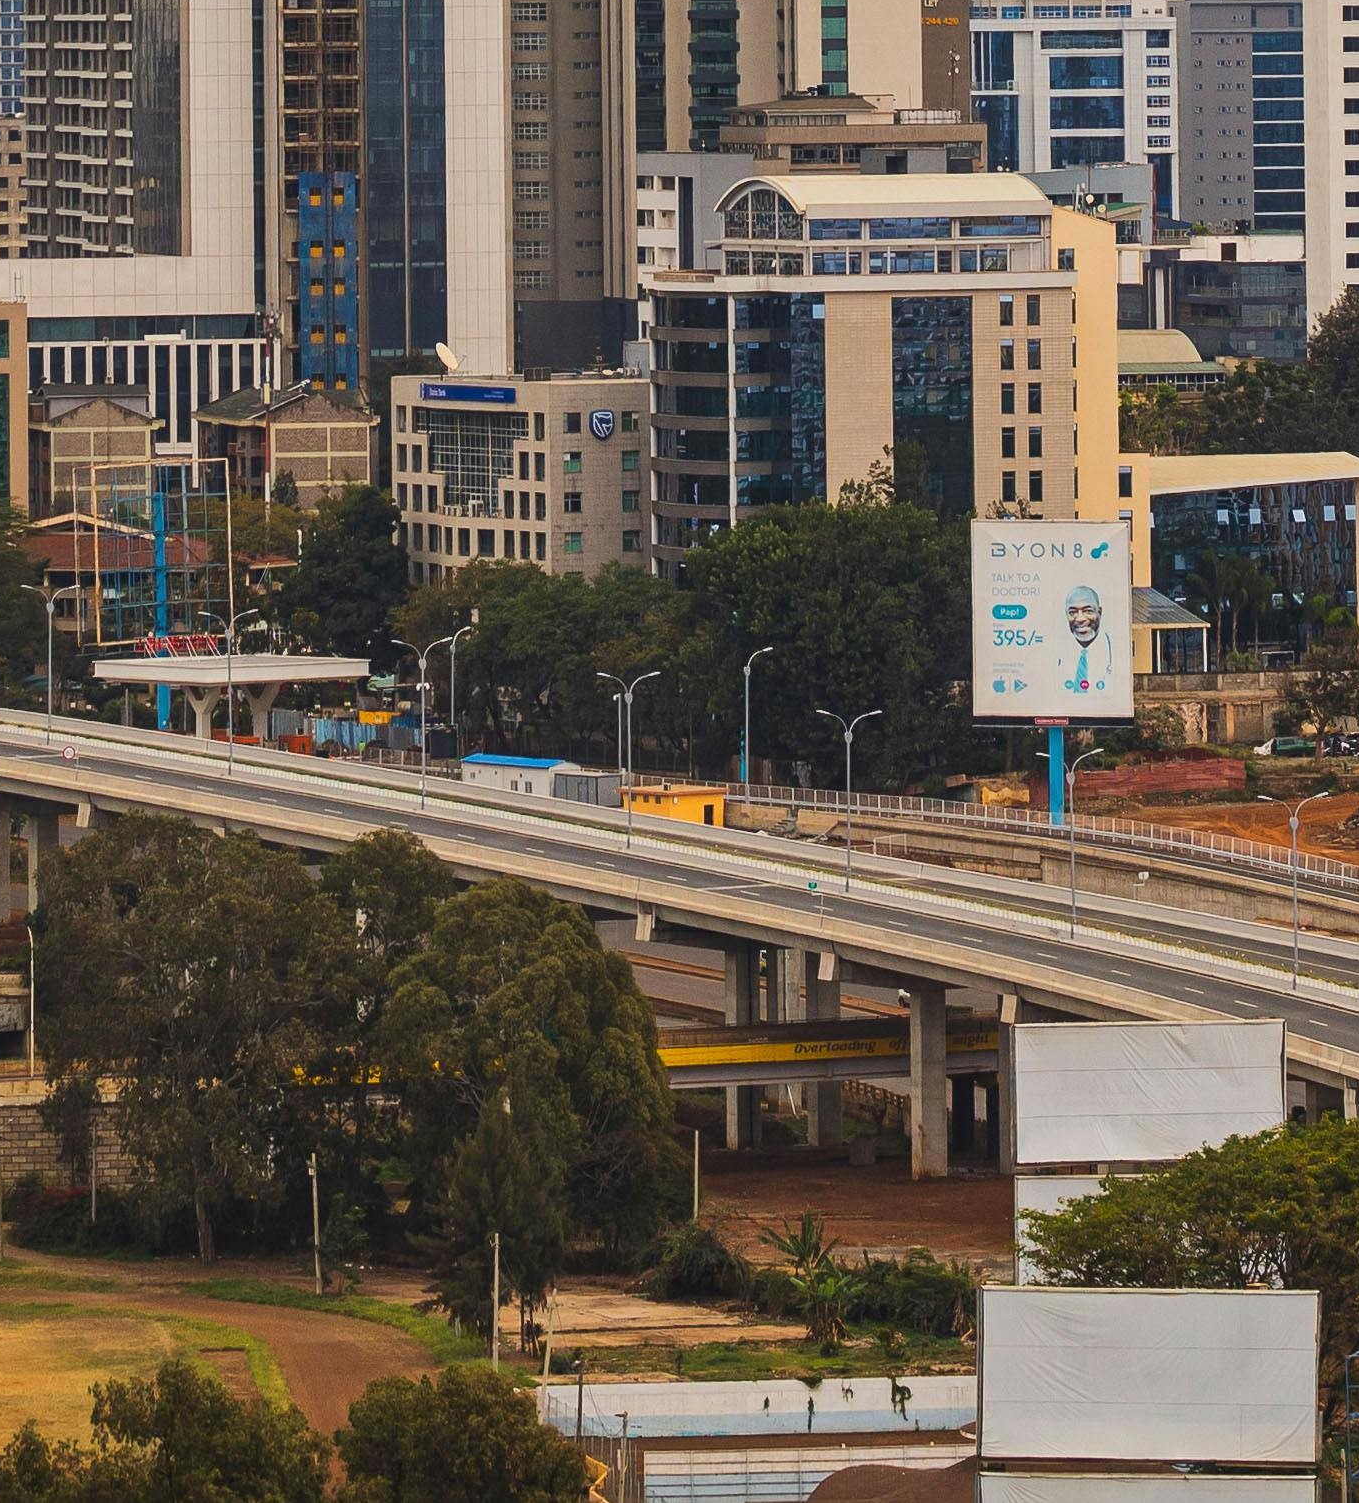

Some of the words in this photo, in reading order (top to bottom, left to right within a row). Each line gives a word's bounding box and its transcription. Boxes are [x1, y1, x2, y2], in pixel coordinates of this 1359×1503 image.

[924, 0, 939, 7] LET
[992, 573, 1015, 582] TALK
[1017, 573, 1031, 582] TO
[992, 629, 1044, 646] 395/=
